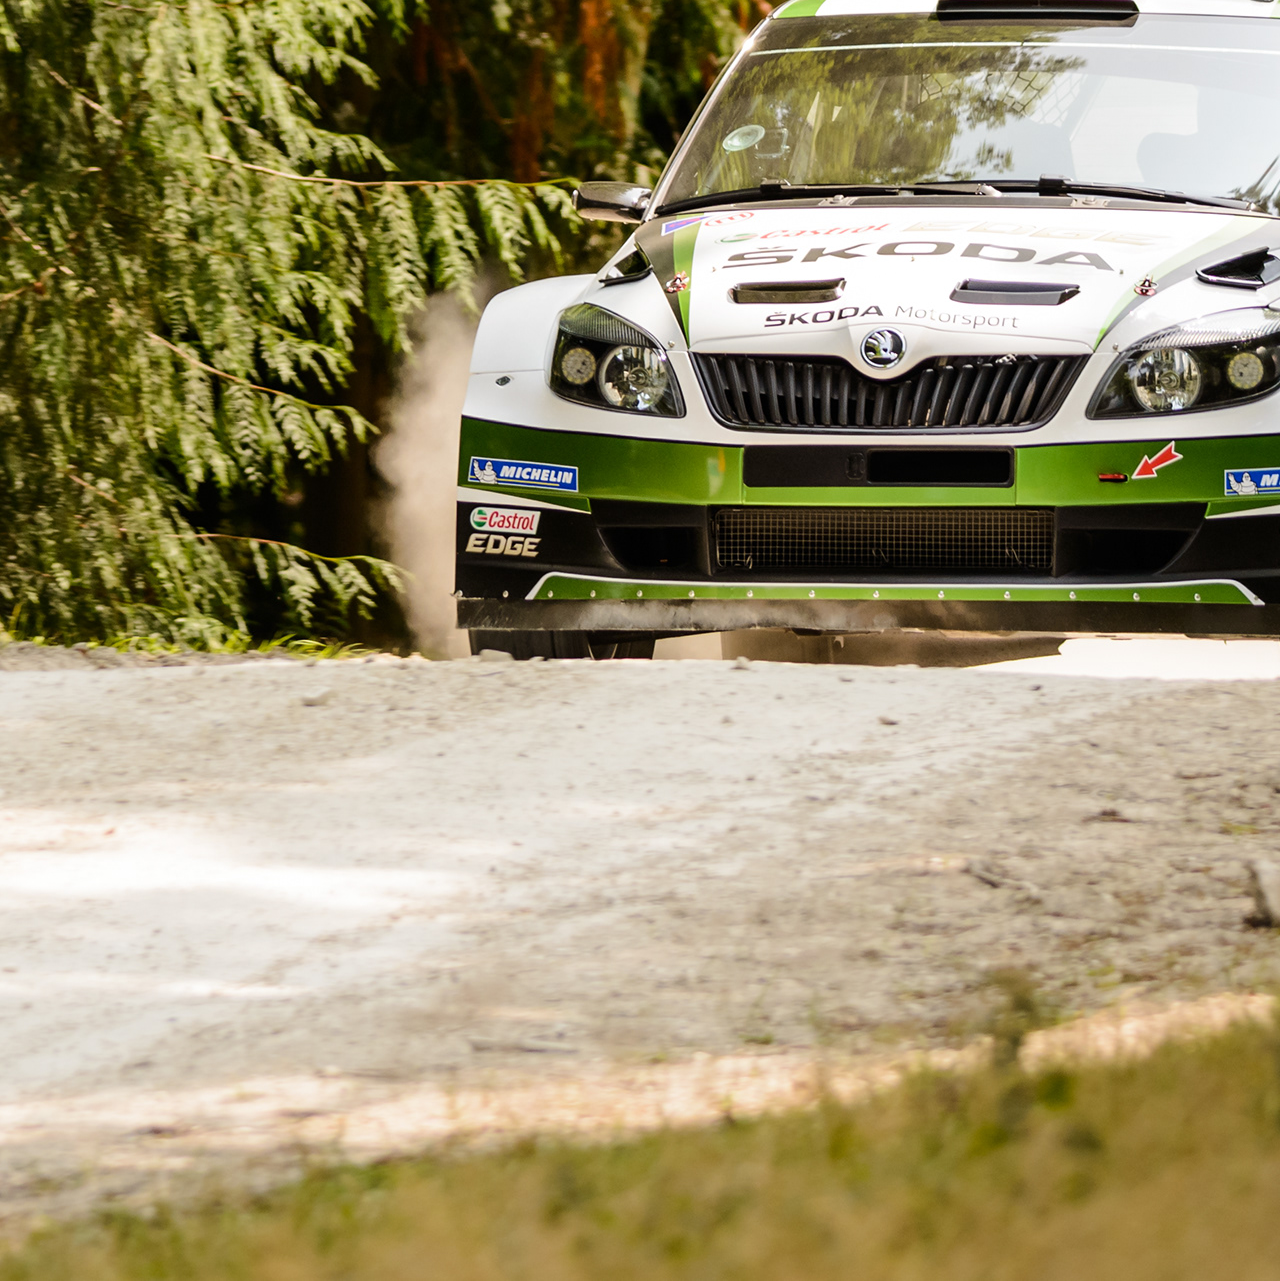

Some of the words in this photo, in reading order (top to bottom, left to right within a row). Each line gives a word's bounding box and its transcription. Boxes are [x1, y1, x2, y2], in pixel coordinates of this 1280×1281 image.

[760, 223, 890, 240] Castrol
[902, 221, 1170, 246] EDGE
[722, 241, 1114, 271] ŠKODA
[764, 305, 884, 327] ŠKODA
[895, 305, 1019, 329] Motorsport
[500, 465, 573, 484] MICHELIN
[488, 511, 535, 531] Castrol
[465, 533, 542, 557] EDGE
